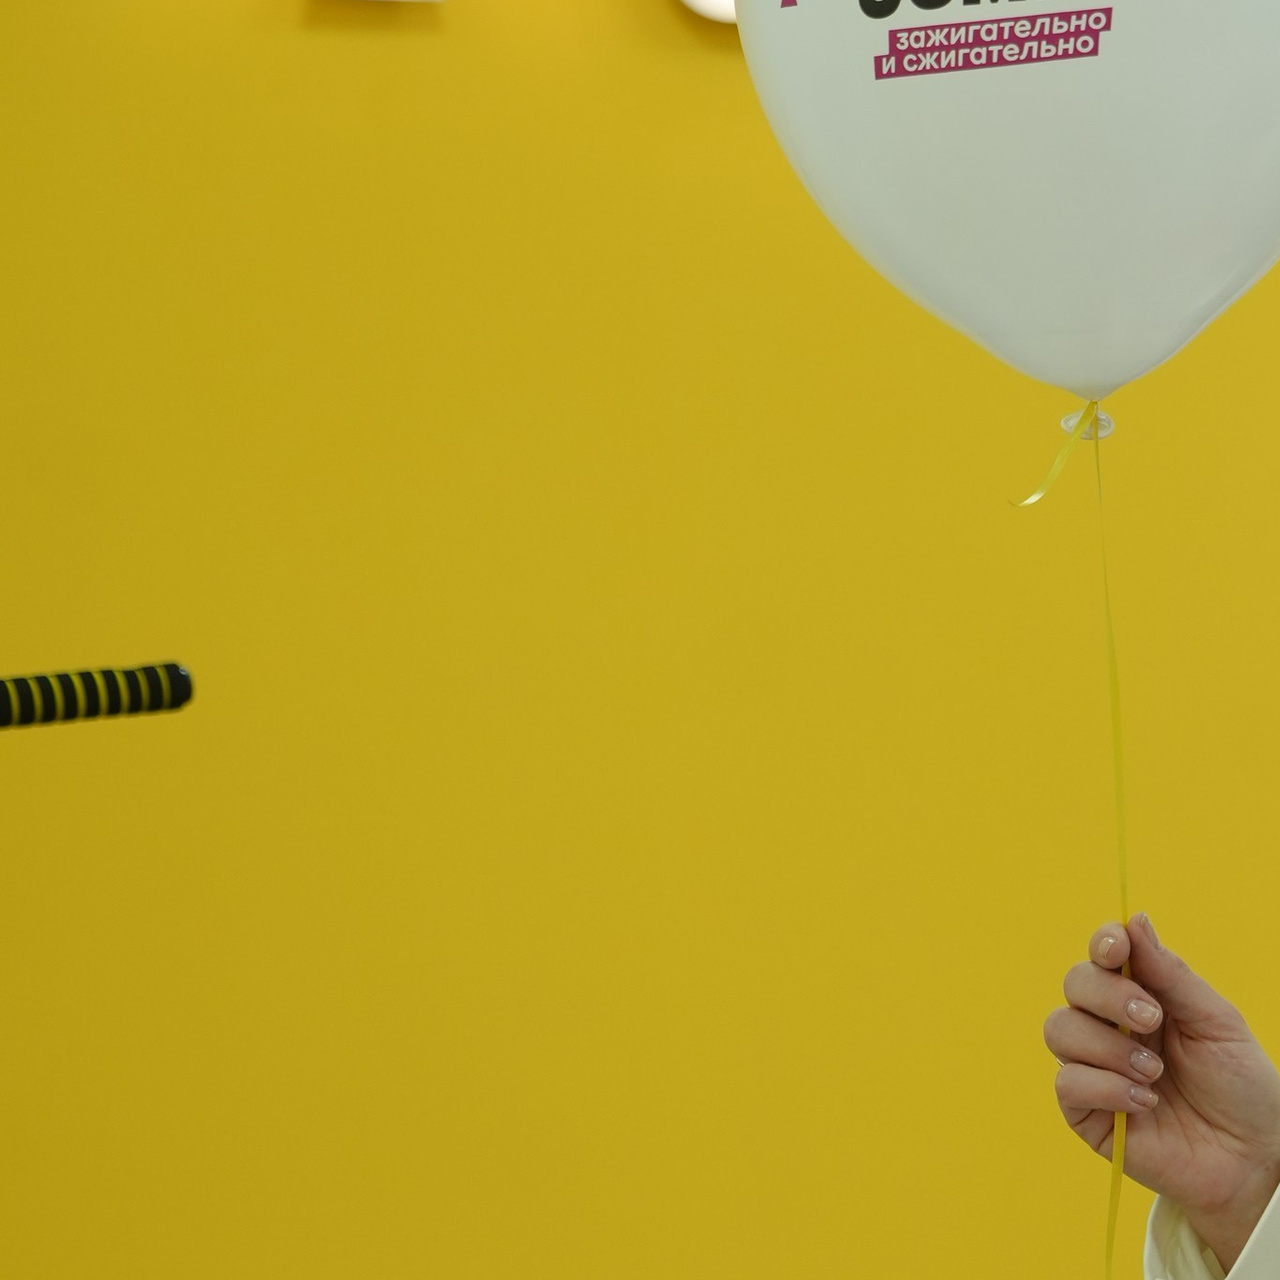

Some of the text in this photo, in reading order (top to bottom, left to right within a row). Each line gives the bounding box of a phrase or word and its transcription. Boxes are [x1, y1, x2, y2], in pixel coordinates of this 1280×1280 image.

[895, 11, 1107, 51] зажигательно
[881, 34, 1095, 75] и сжигательно
